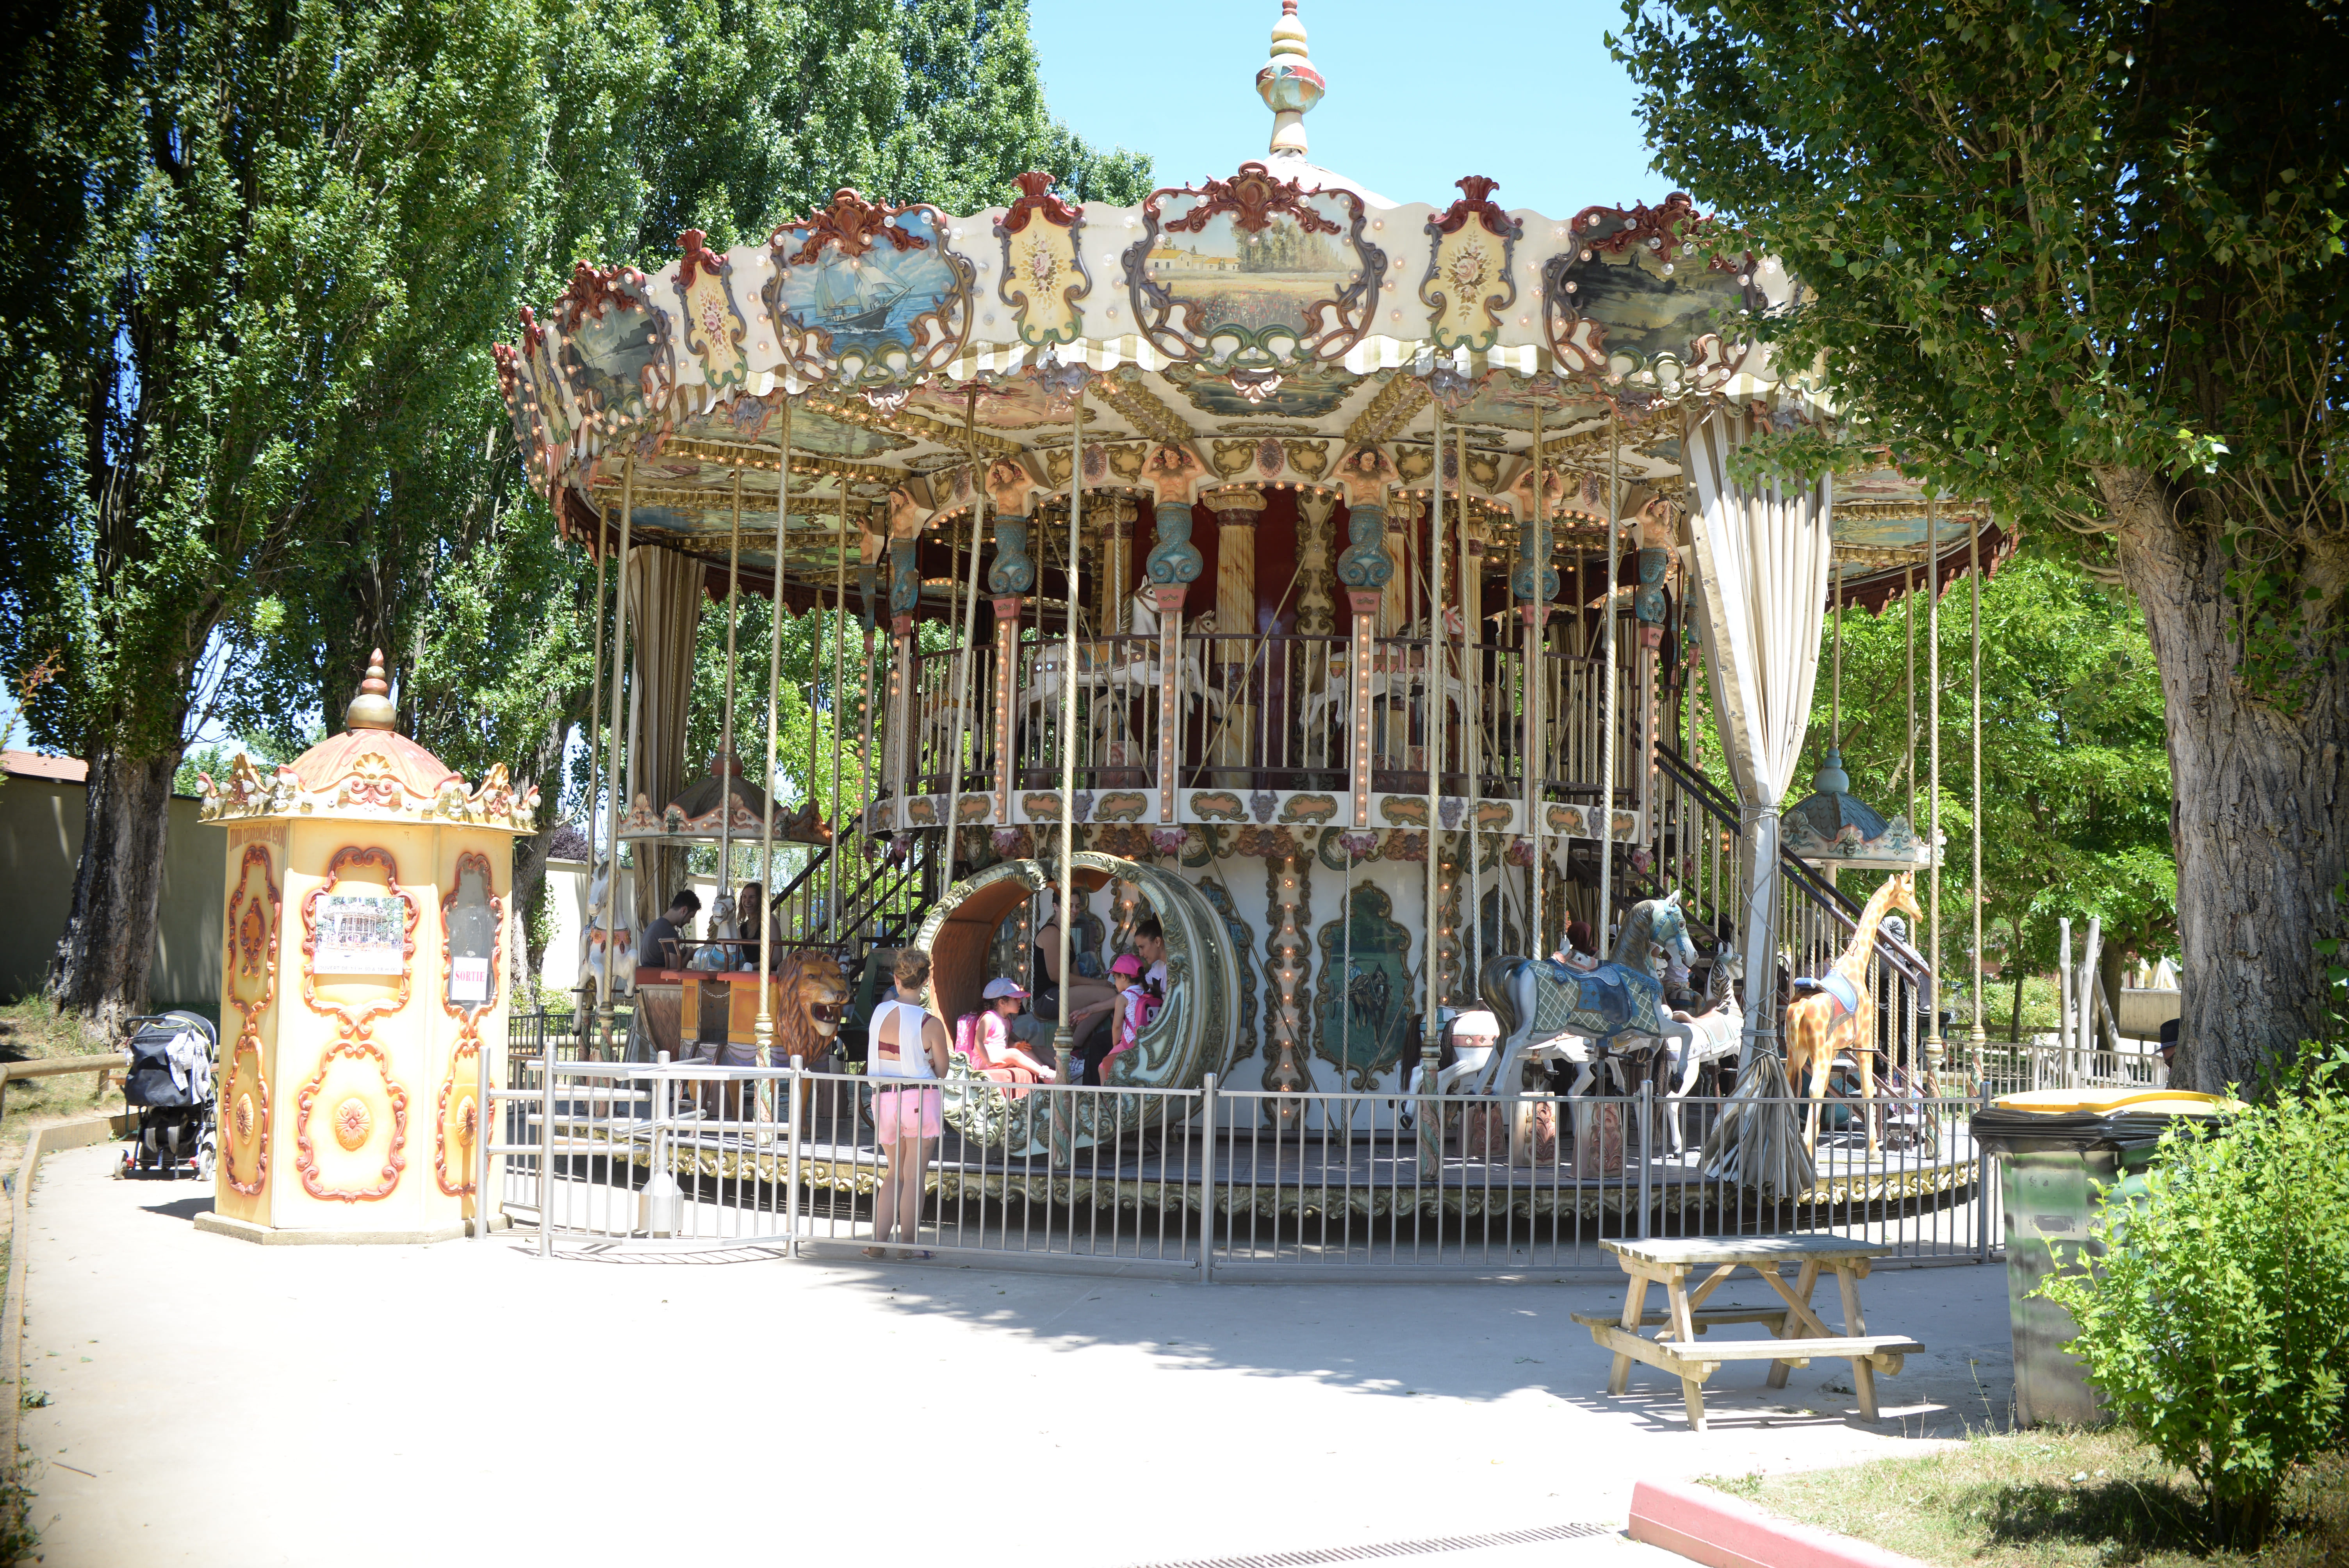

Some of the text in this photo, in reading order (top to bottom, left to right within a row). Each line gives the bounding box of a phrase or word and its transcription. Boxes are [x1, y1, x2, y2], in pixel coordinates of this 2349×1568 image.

[230, 823, 286, 851] mini carrousel 1900
[455, 971, 485, 982] SORTIE
